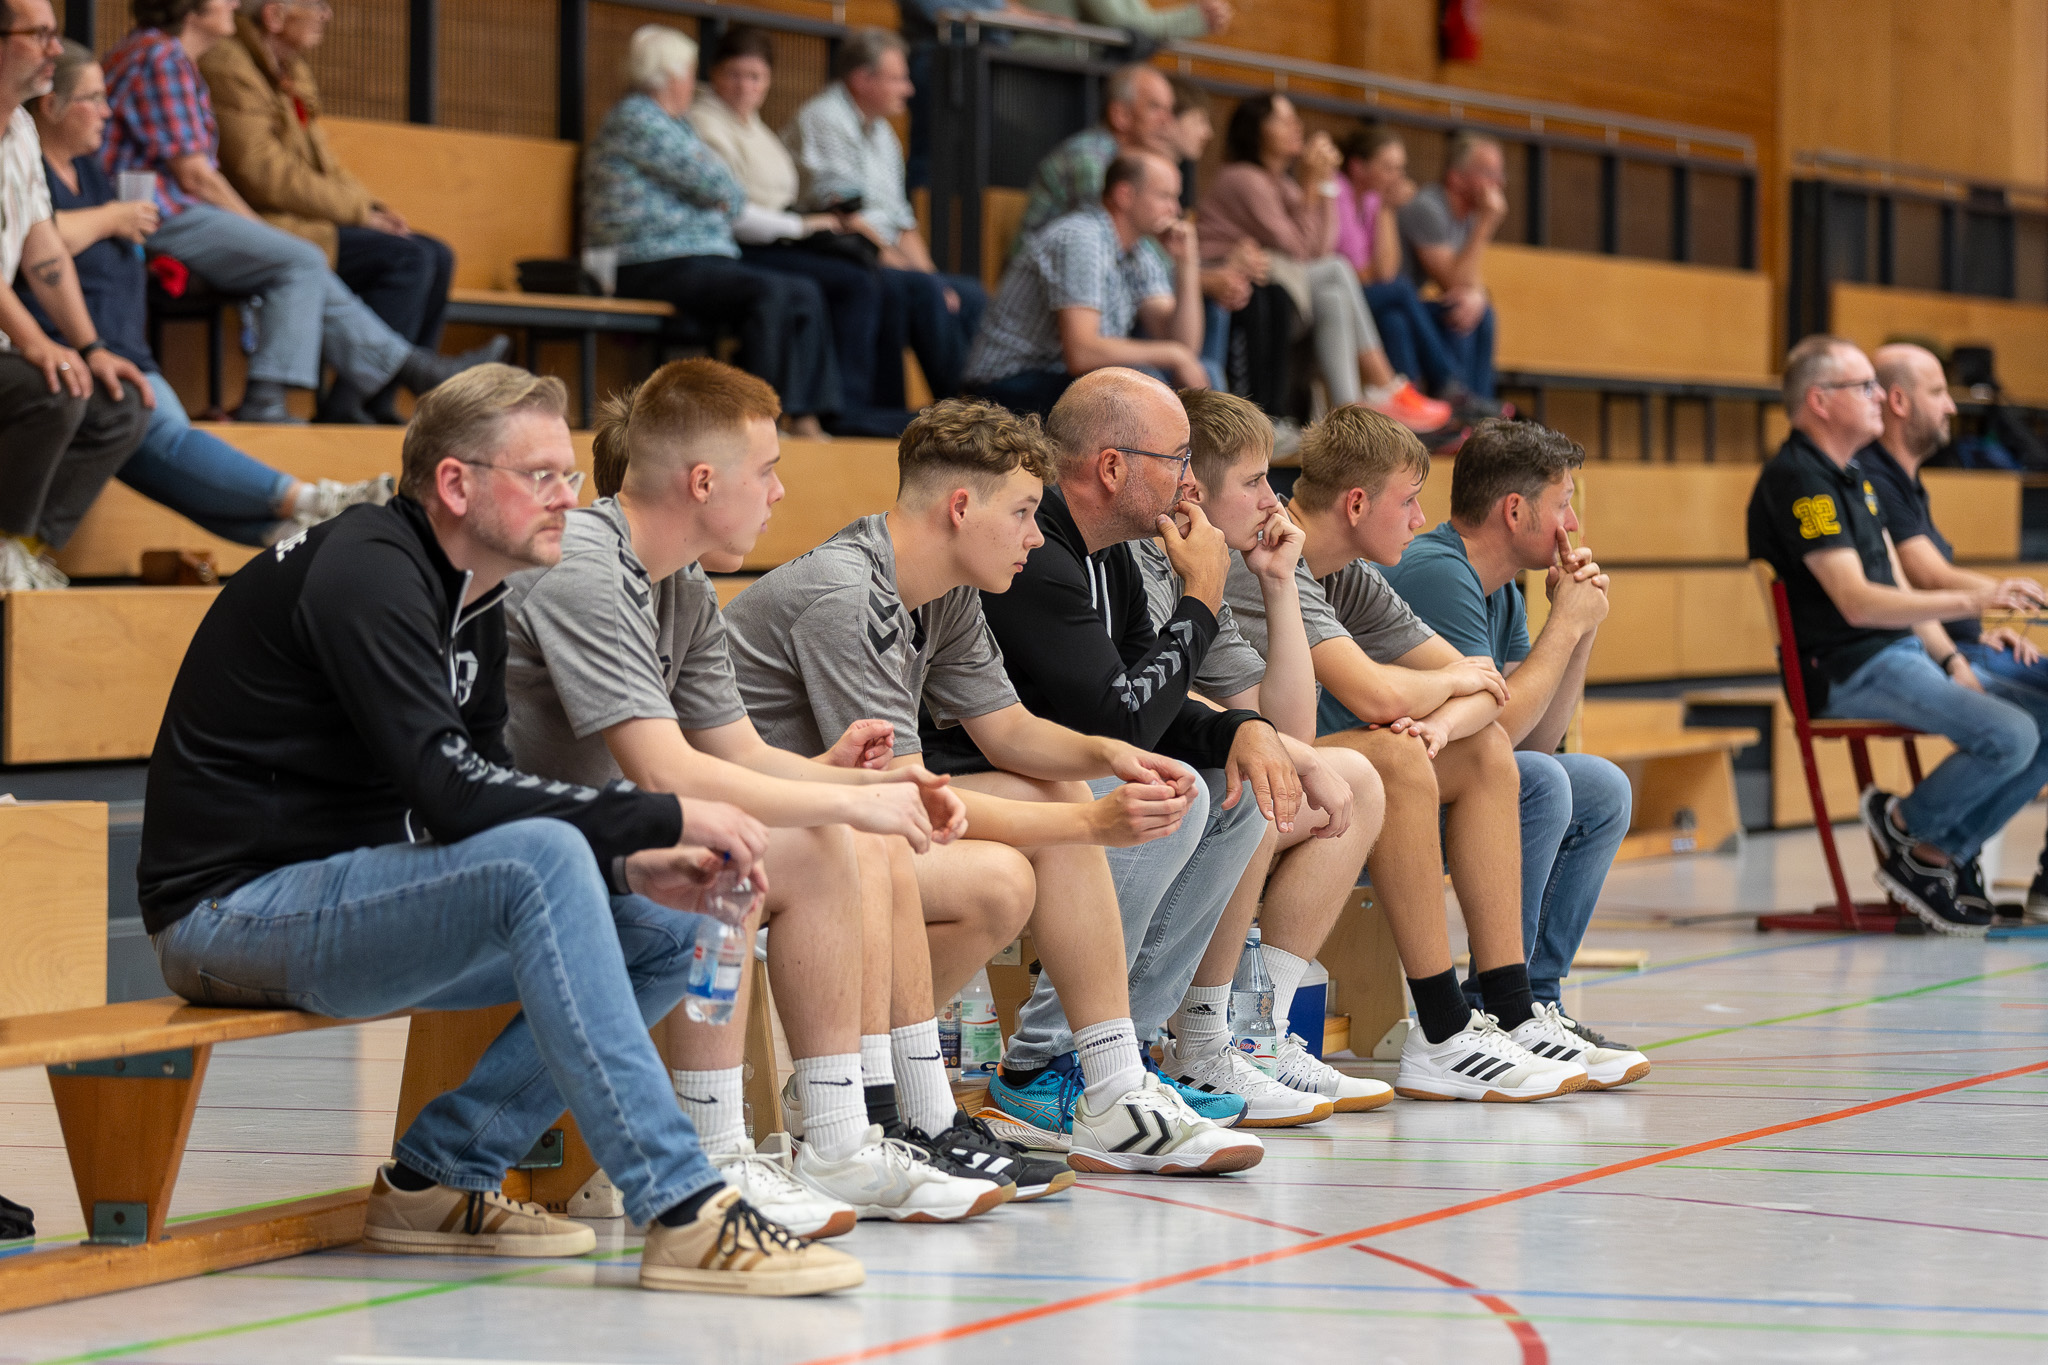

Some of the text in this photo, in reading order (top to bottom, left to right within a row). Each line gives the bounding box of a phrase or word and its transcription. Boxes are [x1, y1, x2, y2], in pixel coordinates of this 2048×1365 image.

[1792, 494, 1842, 540] 32
[1186, 1006, 1217, 1016] adidas
[1235, 1039, 1262, 1050] Leonie
